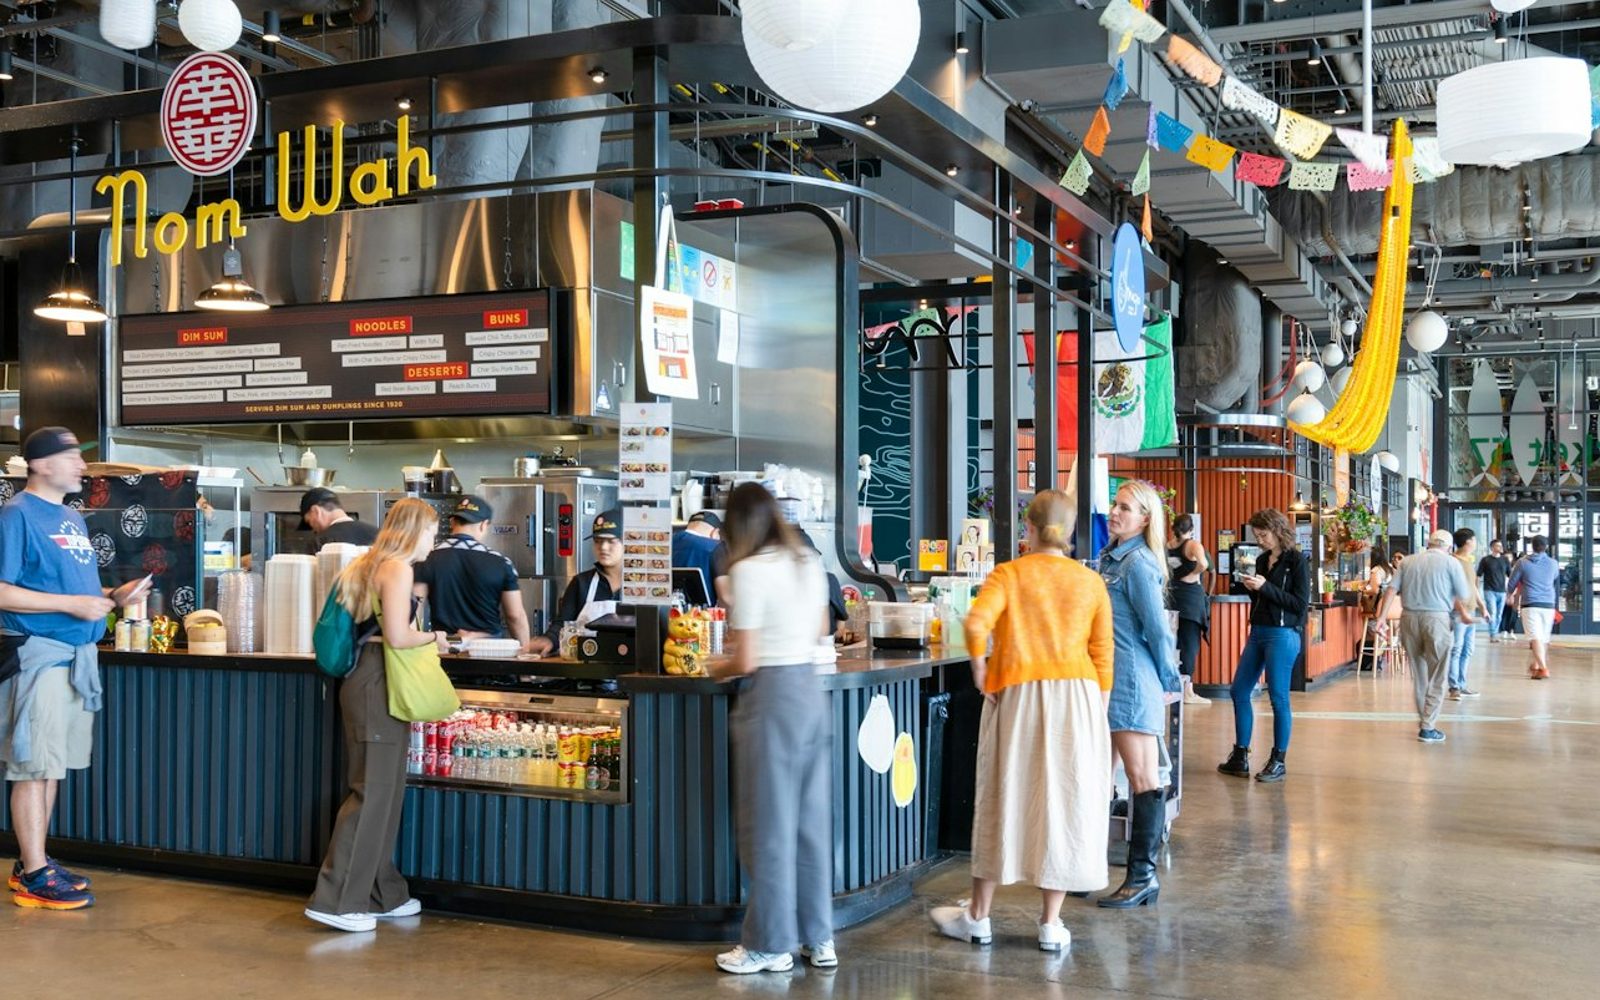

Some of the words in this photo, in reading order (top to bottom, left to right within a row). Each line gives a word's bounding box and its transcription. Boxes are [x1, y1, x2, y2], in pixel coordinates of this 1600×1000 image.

[95, 169, 247, 267] Nom
[278, 114, 437, 223] Wah
[490, 314, 521, 324] BUNS
[355, 320, 406, 332] NOODLES
[182, 331, 200, 342] DIM
[203, 330, 224, 341] SUM
[408, 366, 463, 378] DESSERTS
